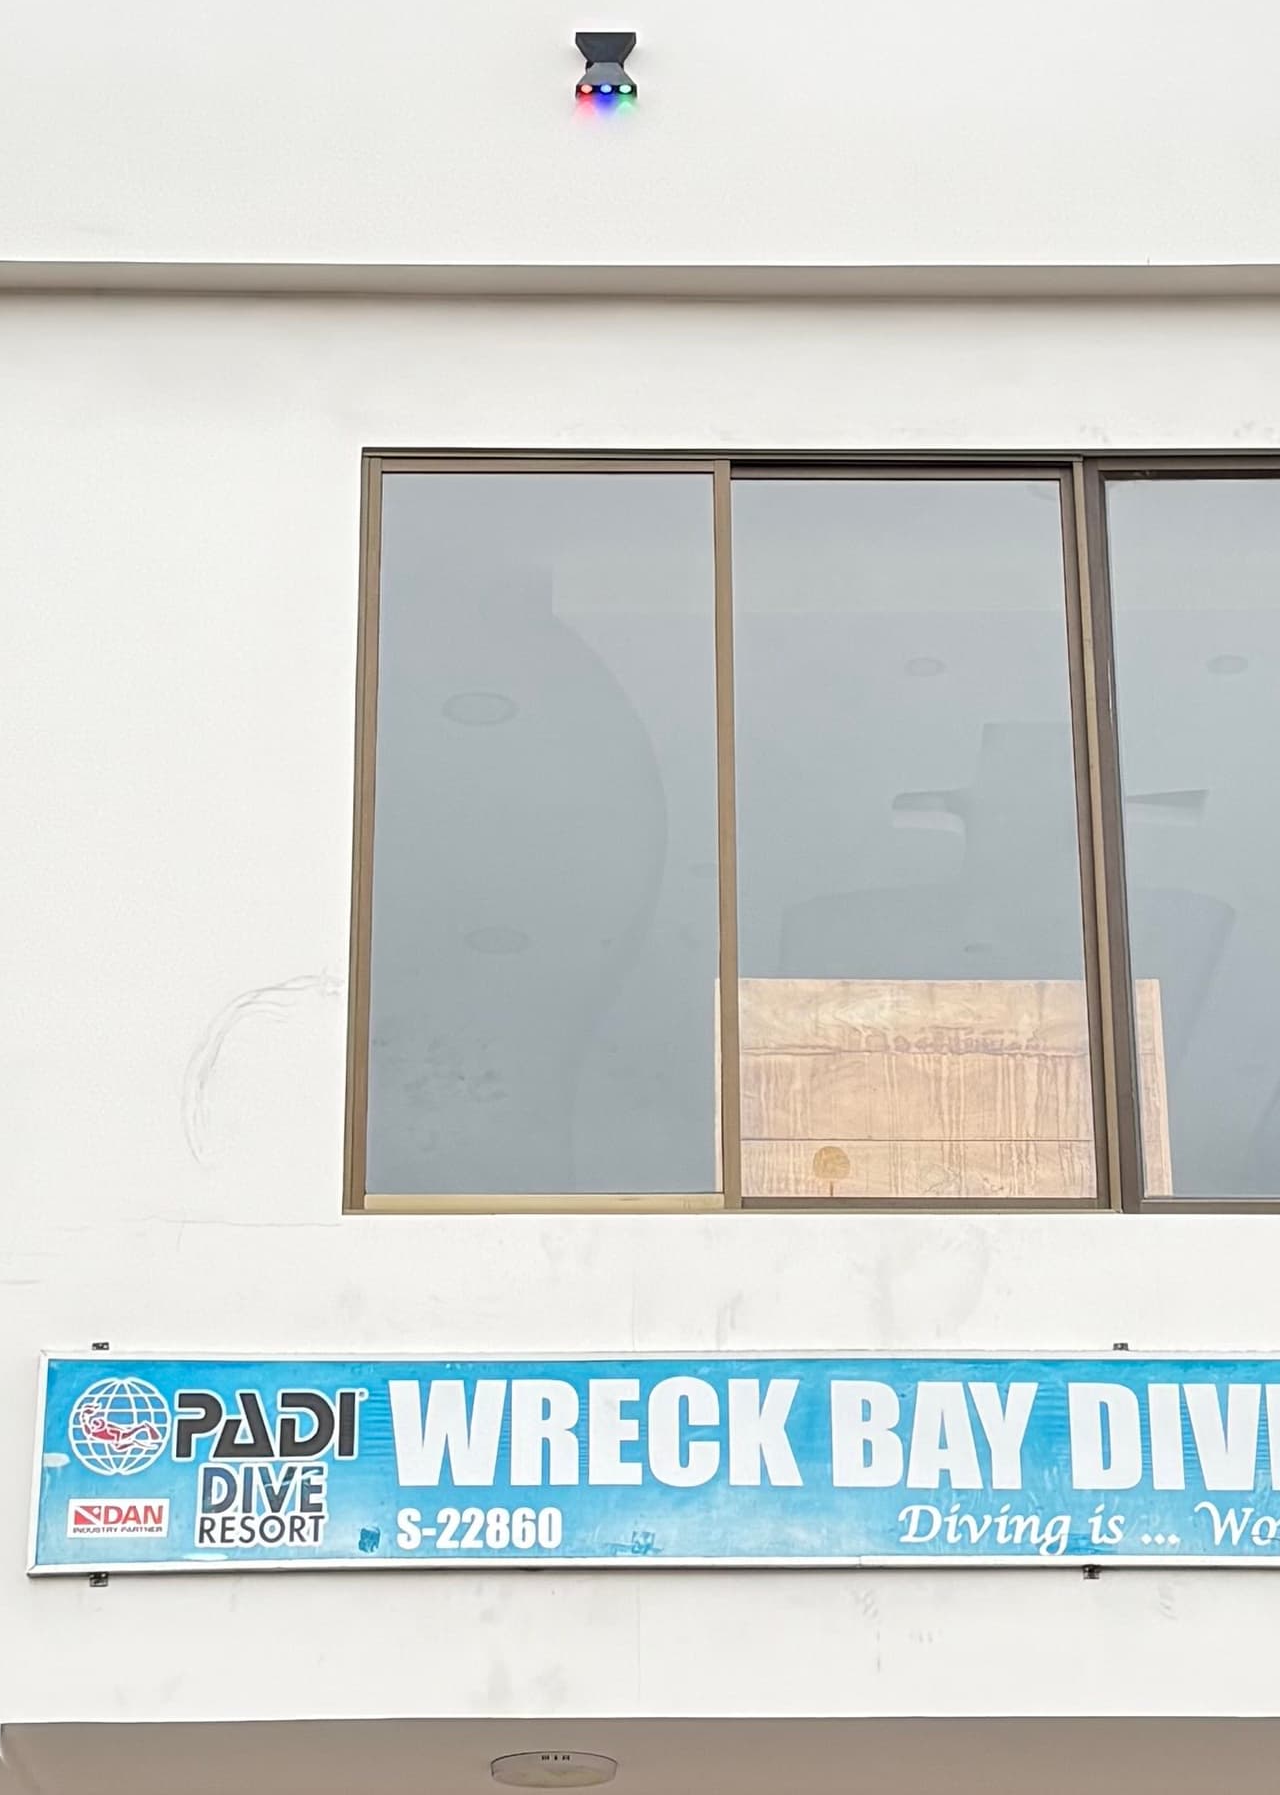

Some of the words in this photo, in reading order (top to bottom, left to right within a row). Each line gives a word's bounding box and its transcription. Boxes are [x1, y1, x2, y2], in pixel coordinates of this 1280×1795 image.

[173, 1391, 357, 1458] PADI
[388, 1376, 803, 1488] WRECK
[830, 1379, 1039, 1491] BAY
[202, 1464, 326, 1515] DIVE
[72, 1526, 118, 1534] INDUSTRY
[120, 1526, 163, 1534] PARTNER
[103, 1505, 164, 1525] DAN
[198, 1515, 326, 1544] RESORT
[397, 1507, 562, 1550] S-22860
[898, 1504, 1070, 1557] Diving
